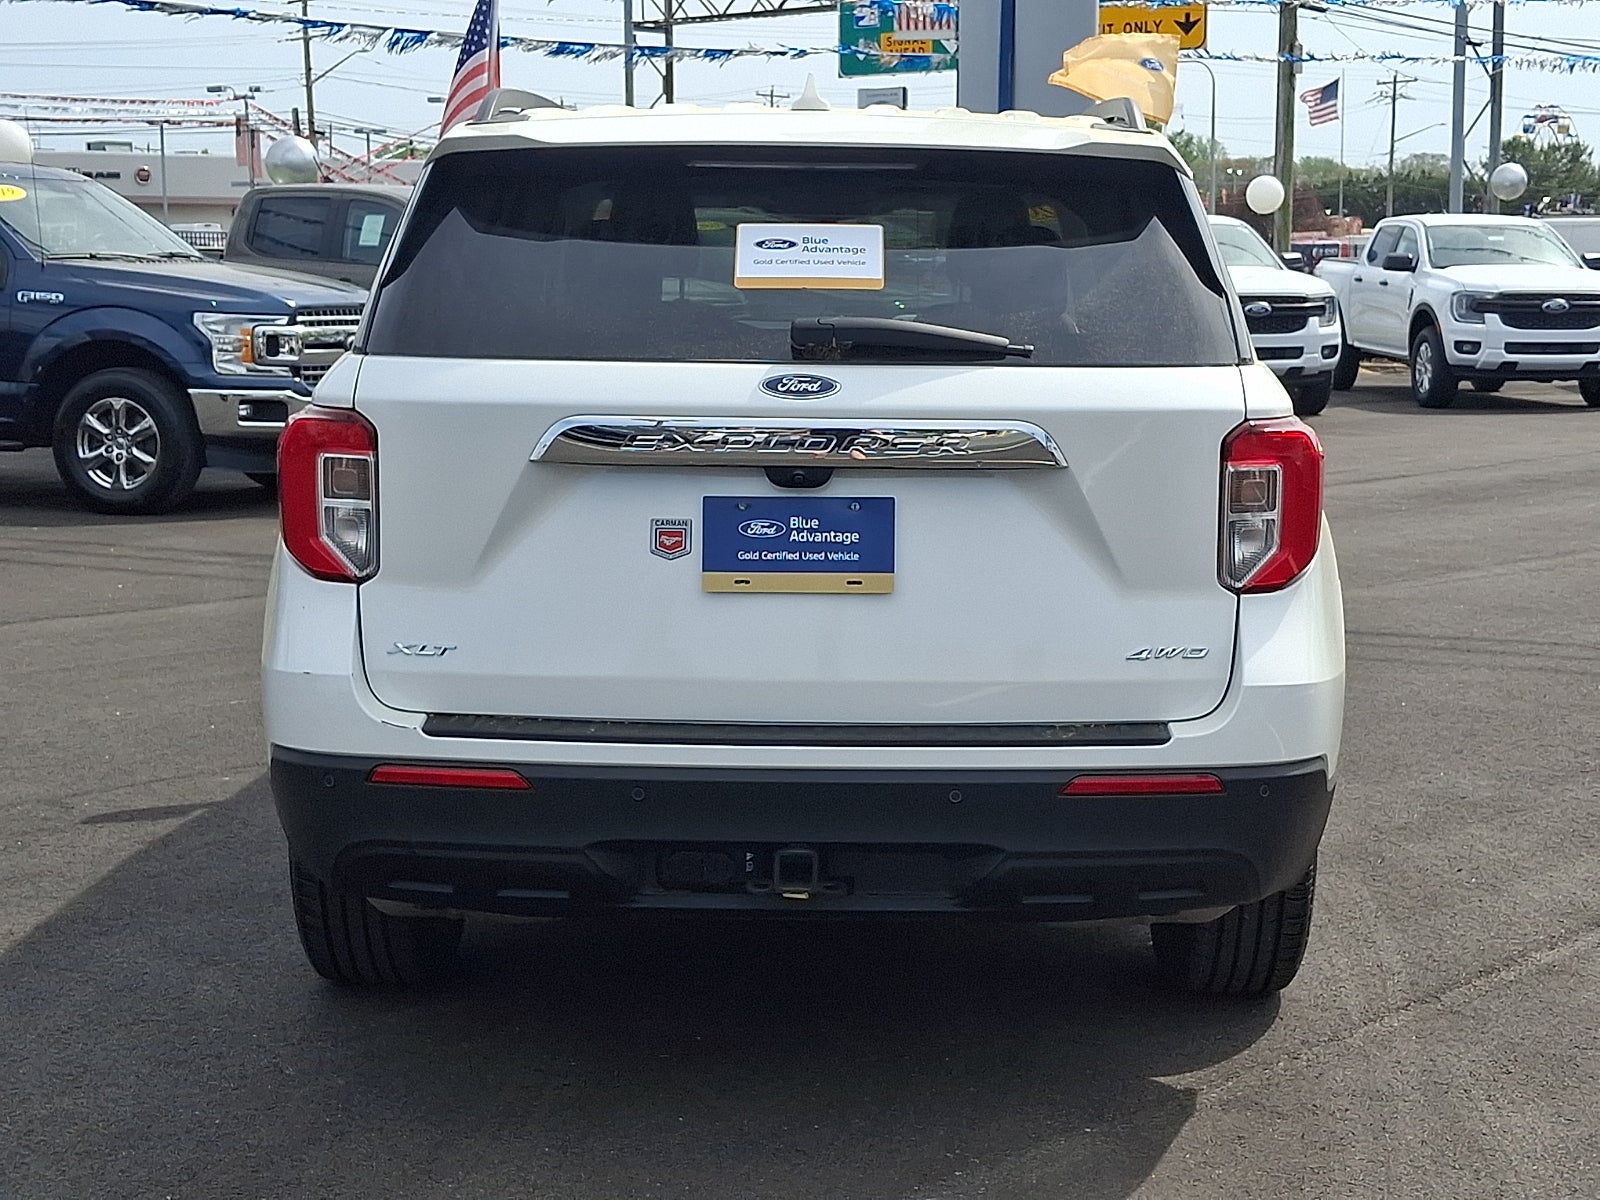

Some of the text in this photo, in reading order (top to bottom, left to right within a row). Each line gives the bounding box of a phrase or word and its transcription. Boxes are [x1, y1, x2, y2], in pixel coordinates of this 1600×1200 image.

[1123, 20, 1163, 34] ONLY
[802, 236, 829, 245] Blue
[801, 245, 867, 255] Advantage
[620, 432, 974, 455] EXPLORER
[654, 519, 688, 527] CARMAN
[789, 516, 820, 529] Blue
[789, 530, 860, 545] Advantage
[737, 551, 860, 561] Gold Certified Used Vehicle
[386, 641, 458, 657] XLT
[1126, 646, 1210, 661] 4WD
